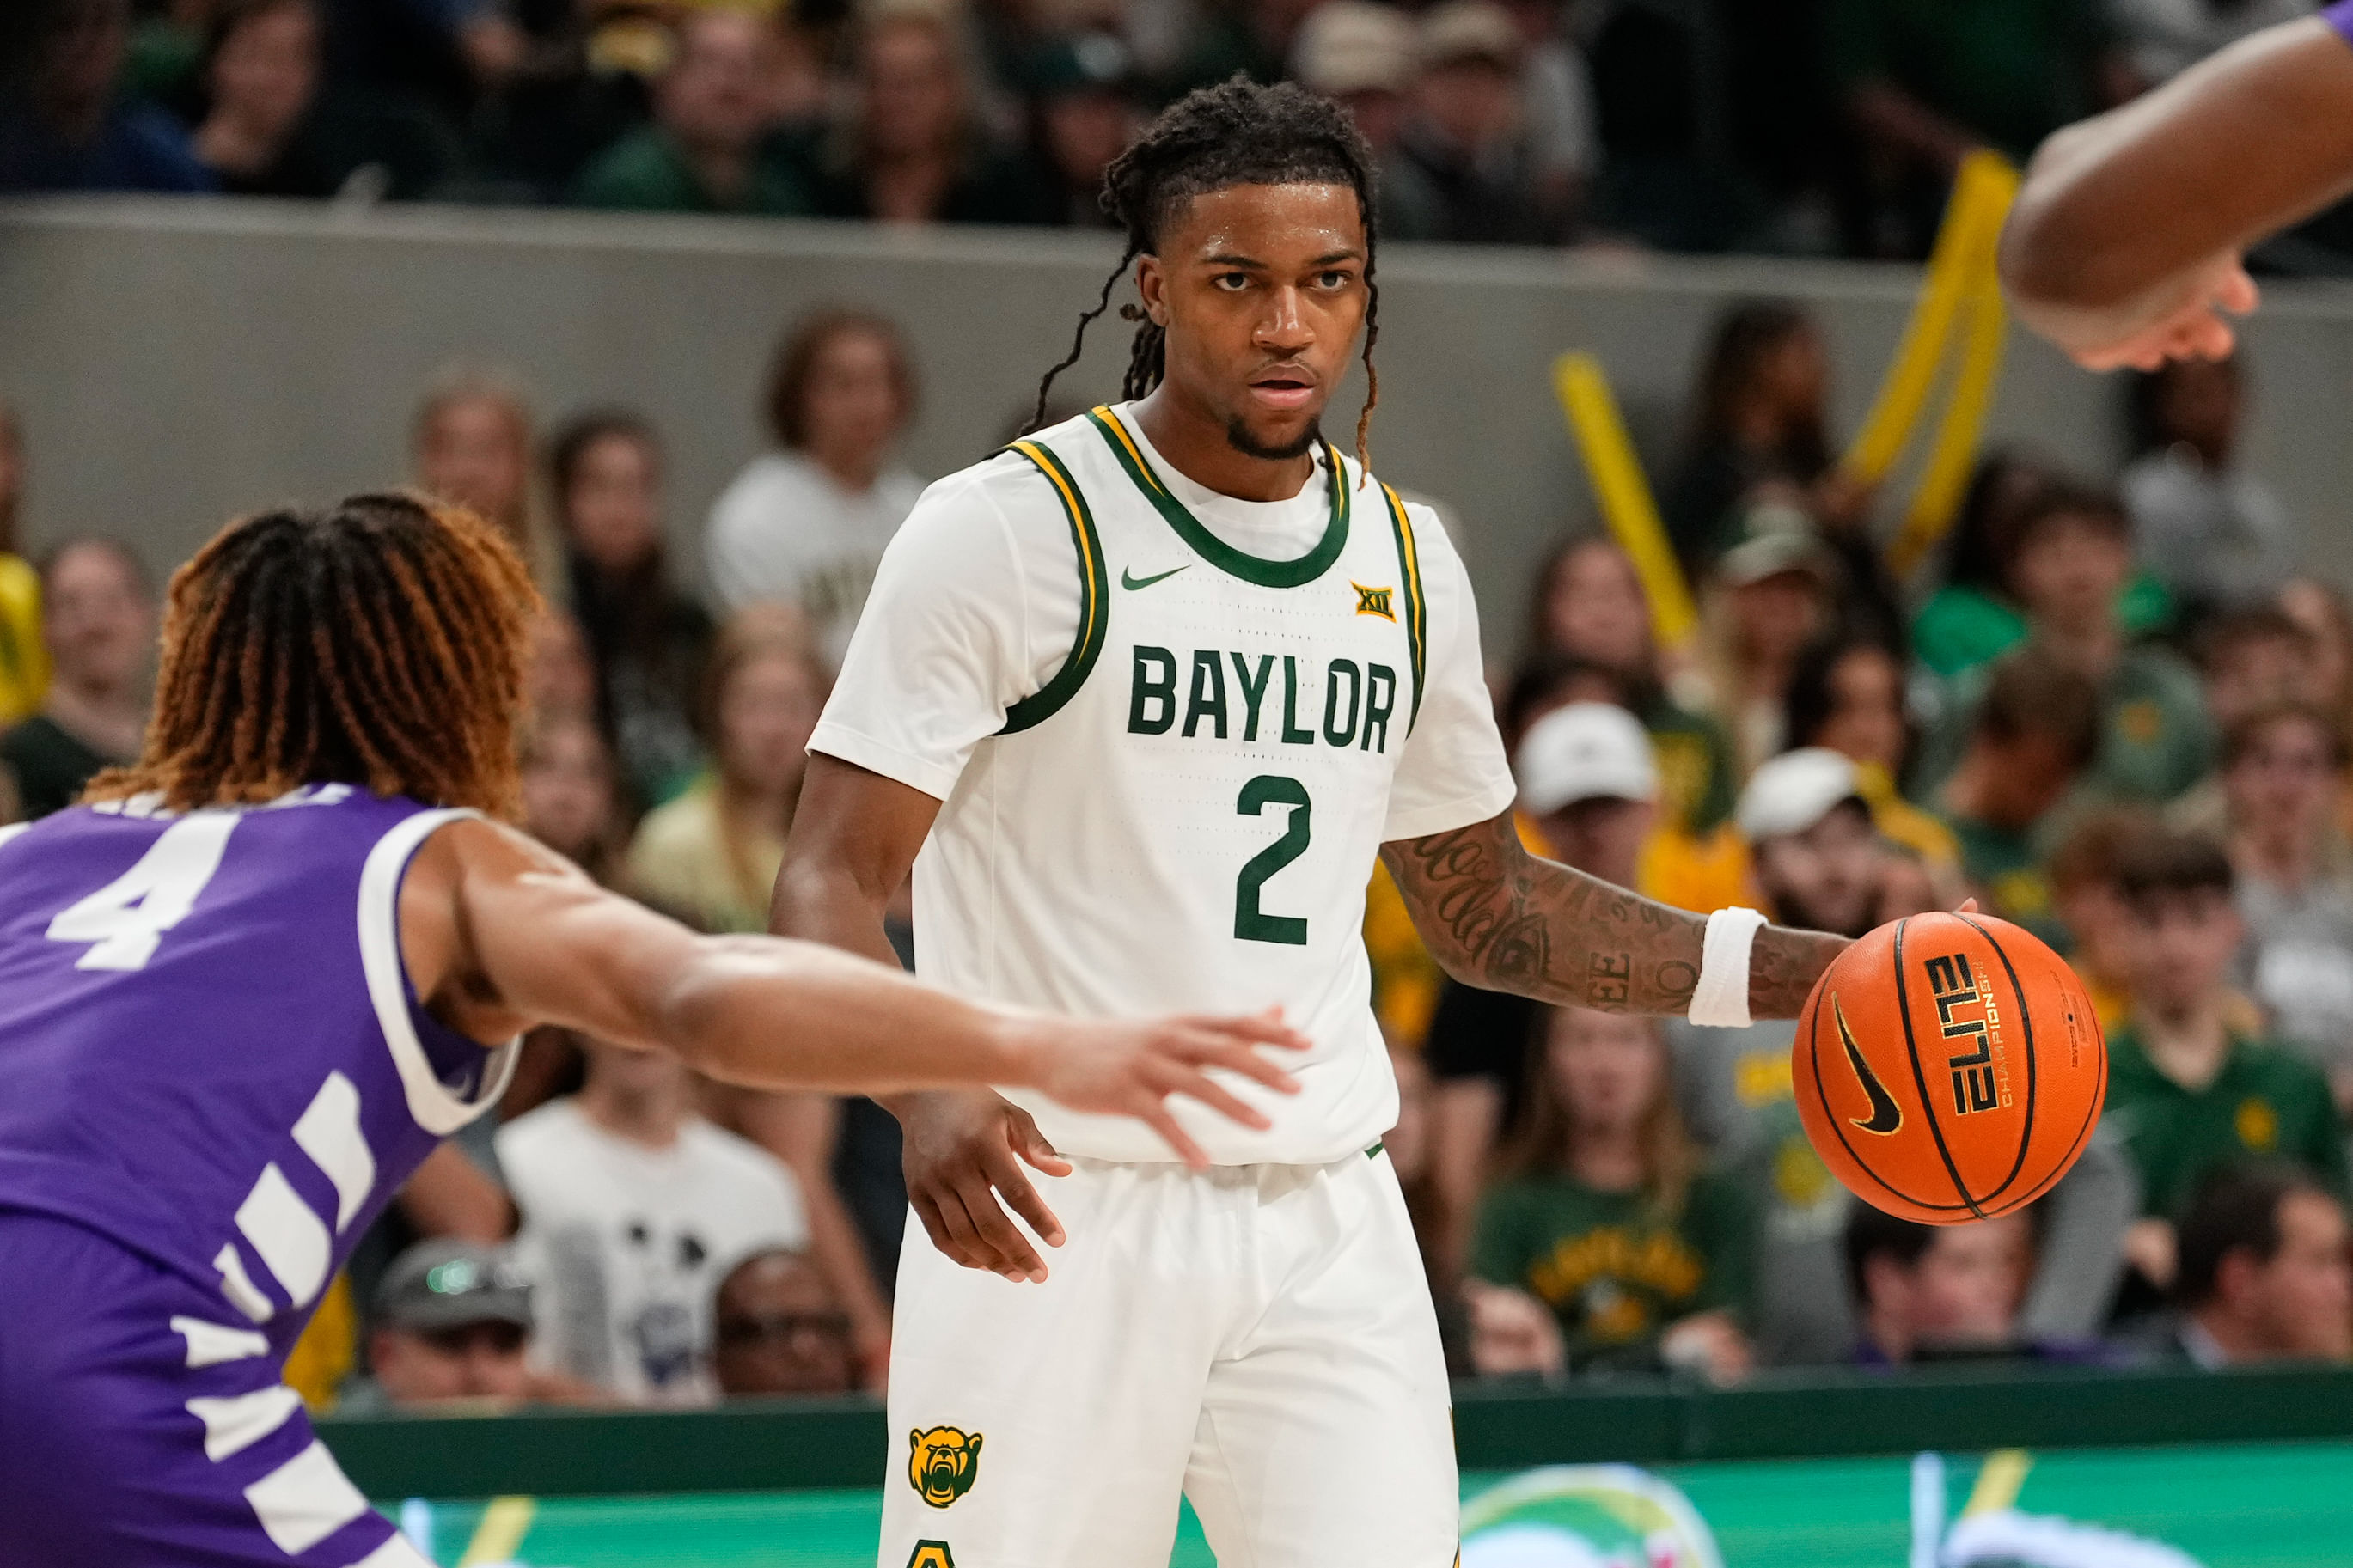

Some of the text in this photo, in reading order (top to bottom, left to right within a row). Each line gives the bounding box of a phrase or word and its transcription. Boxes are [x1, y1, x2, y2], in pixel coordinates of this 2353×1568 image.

[1350, 580, 1397, 623] XII
[1127, 644, 1397, 754] BAYLOR
[44, 811, 241, 972] 4
[1234, 774, 1311, 946] 2
[1924, 953, 1999, 1116] ELITE
[1970, 951, 2013, 1108] CHAMPIONSHI
